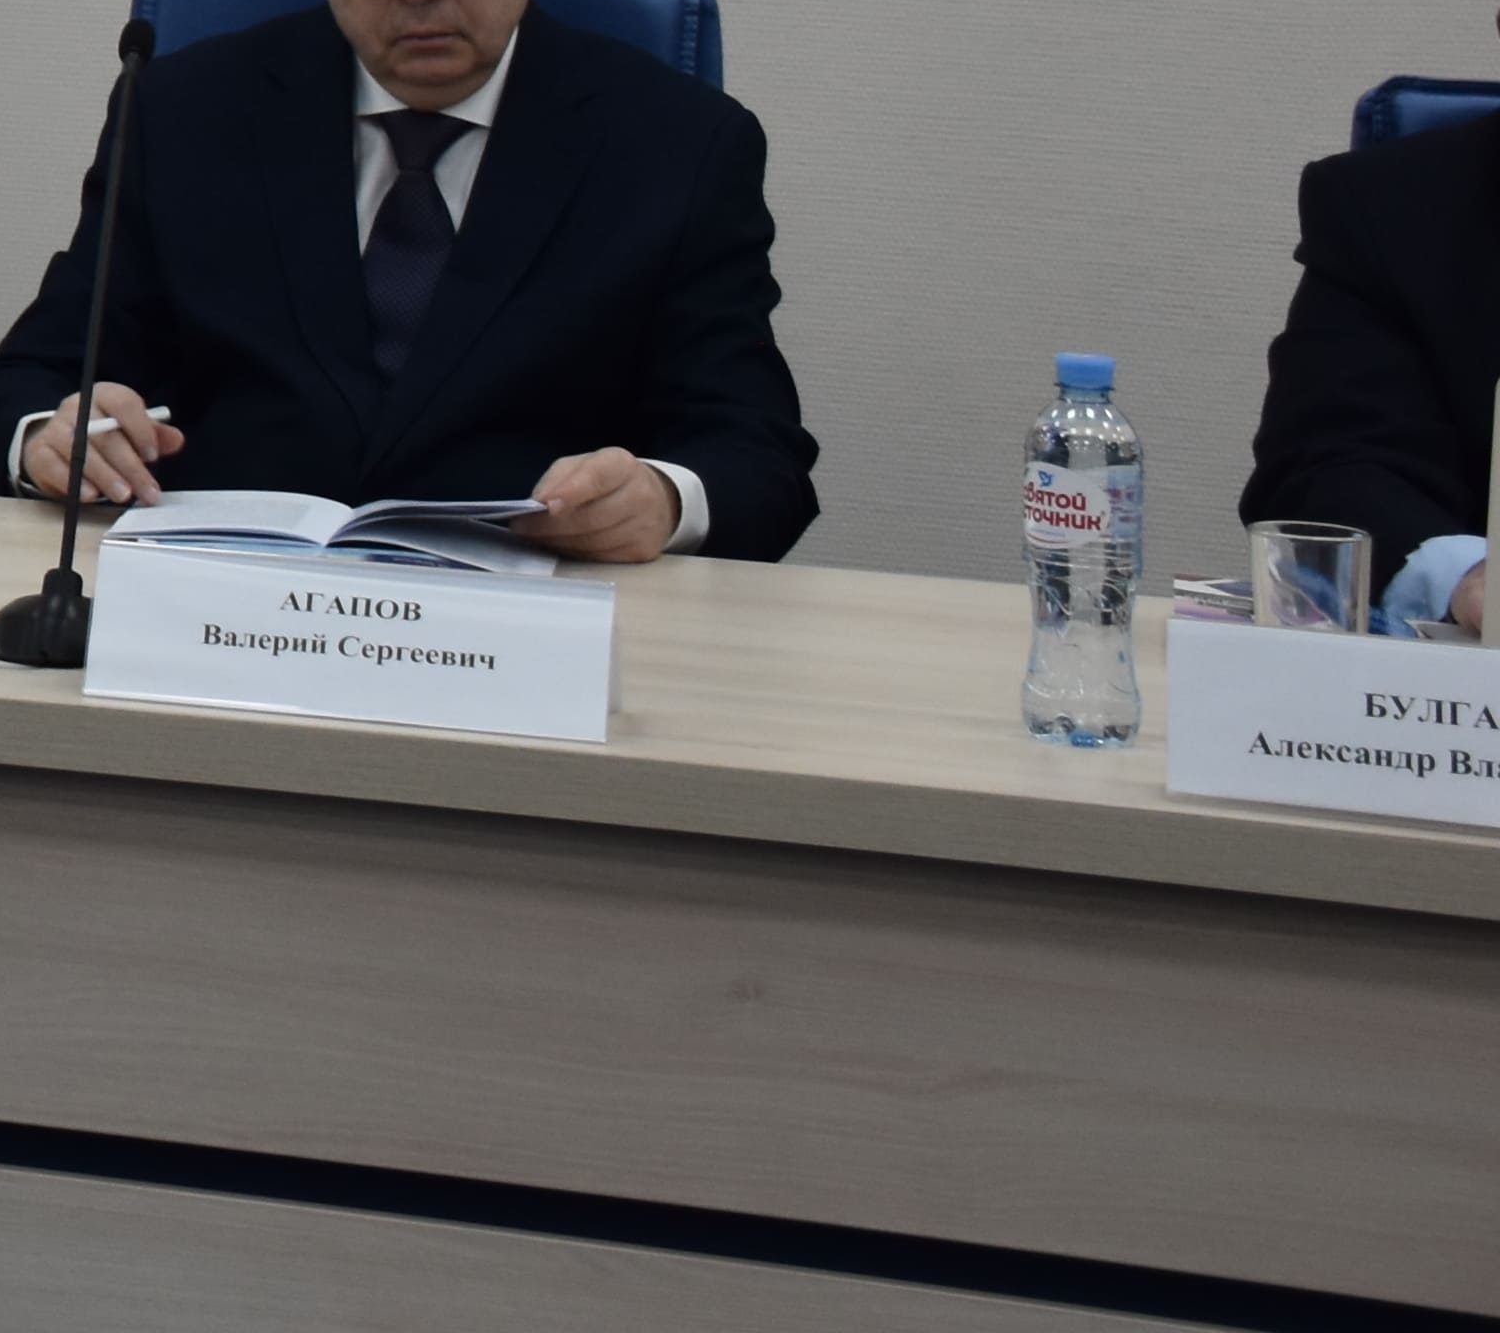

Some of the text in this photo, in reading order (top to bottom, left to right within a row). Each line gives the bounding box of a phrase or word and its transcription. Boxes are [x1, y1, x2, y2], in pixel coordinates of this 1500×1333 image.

[1023, 504, 1102, 531] точник
[279, 590, 423, 622] АГАПОВ
[202, 622, 496, 671] Валерий Сергеевич
[1363, 691, 1500, 730] БУЛГА
[1248, 730, 1500, 779] Александр Вл
